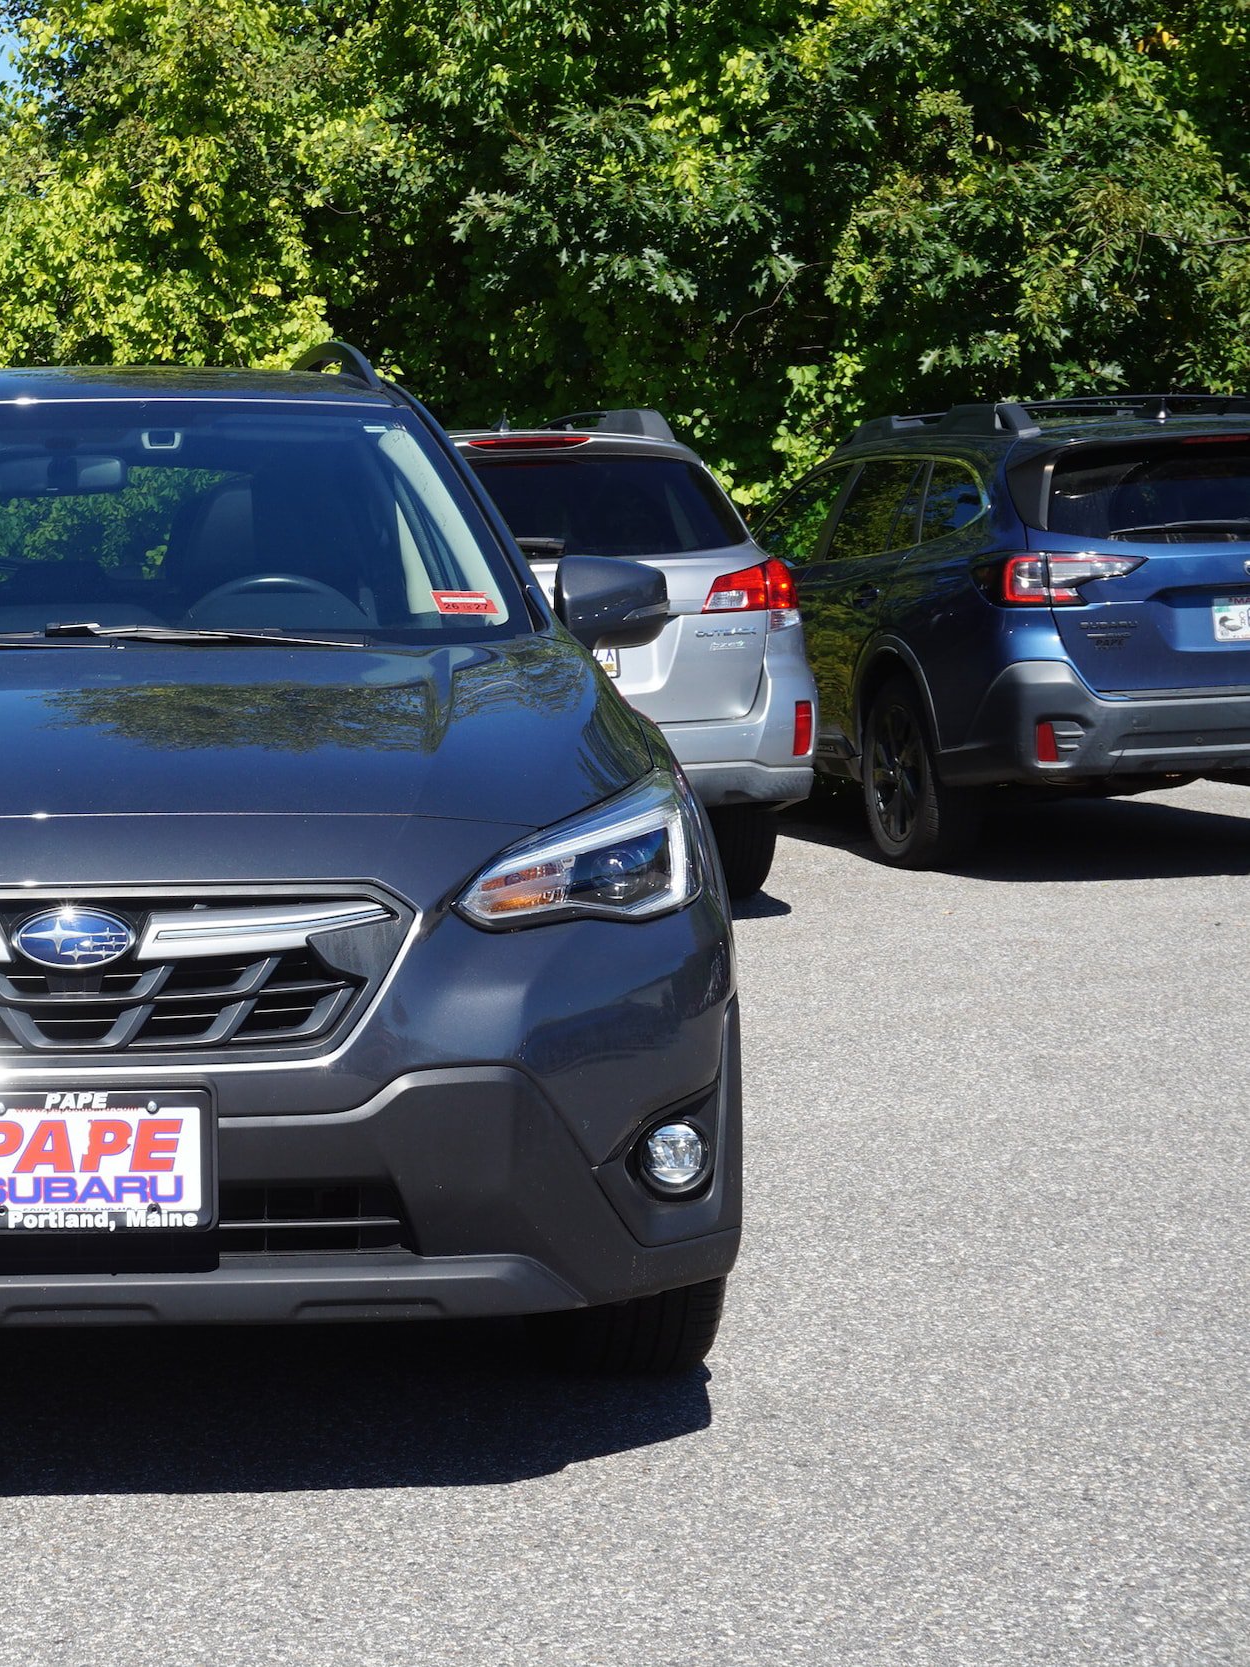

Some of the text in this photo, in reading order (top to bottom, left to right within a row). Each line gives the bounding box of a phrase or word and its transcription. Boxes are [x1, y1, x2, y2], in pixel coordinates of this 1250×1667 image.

[1079, 620, 1138, 629] SUBARU
[44, 1091, 108, 1109] PAPE
[8, 1209, 116, 1232] Portland,
[126, 1209, 198, 1229] Maine
